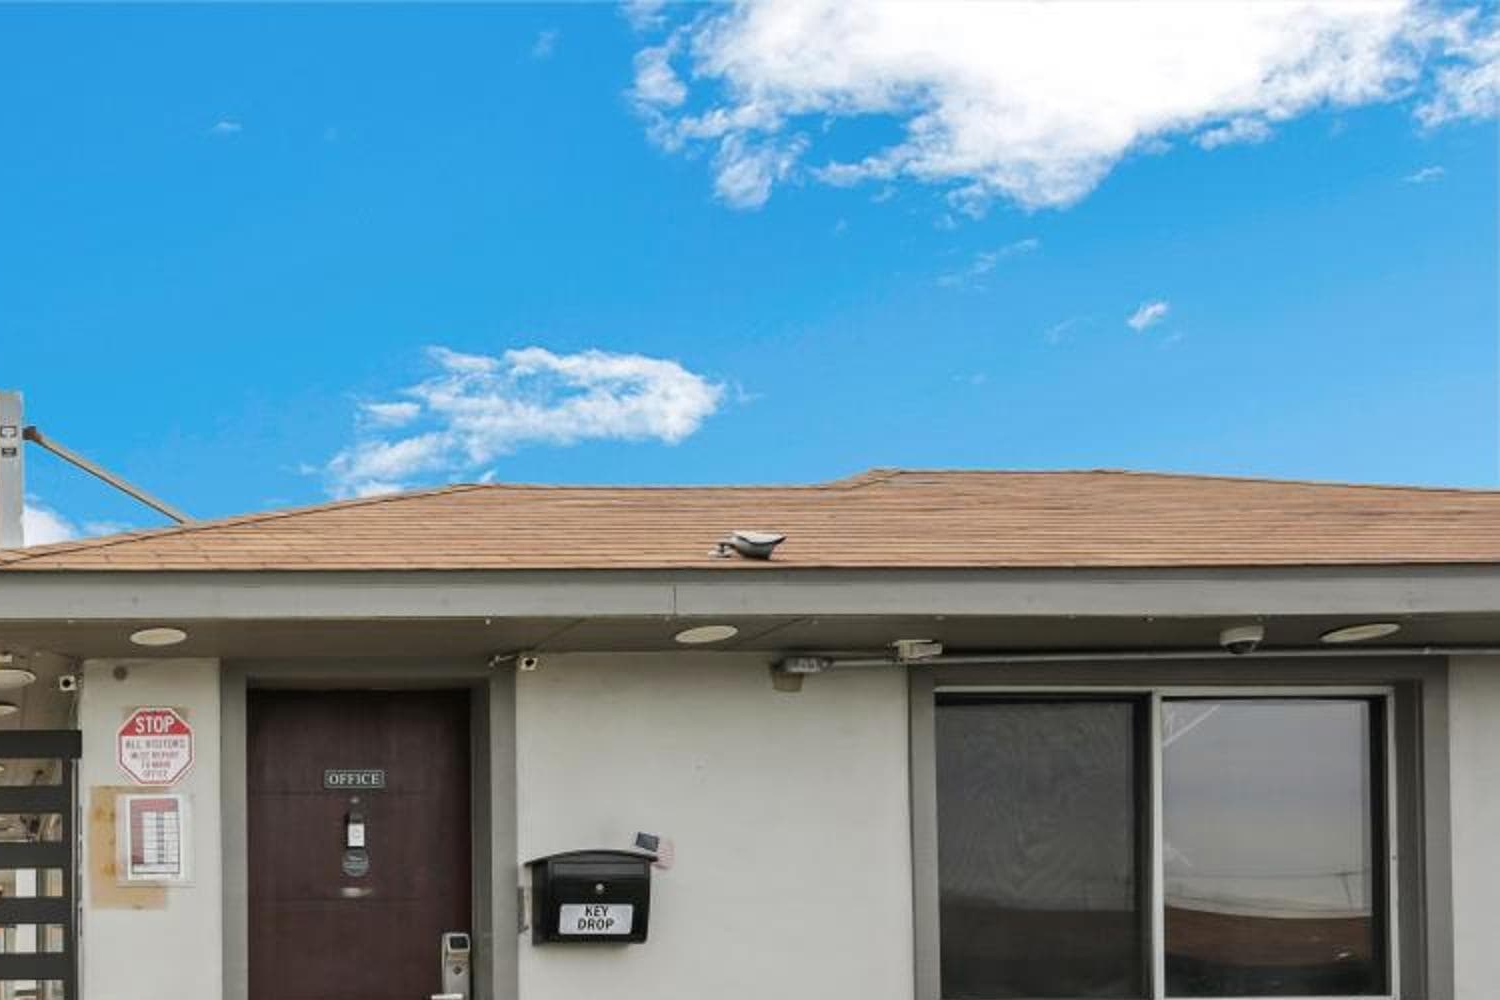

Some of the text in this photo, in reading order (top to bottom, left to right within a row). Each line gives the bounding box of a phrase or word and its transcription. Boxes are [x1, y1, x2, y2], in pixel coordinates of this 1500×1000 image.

[135, 715, 175, 733] STOP
[328, 772, 380, 786] OFFICE
[584, 905, 610, 918] KEY
[576, 917, 616, 931] DROP
